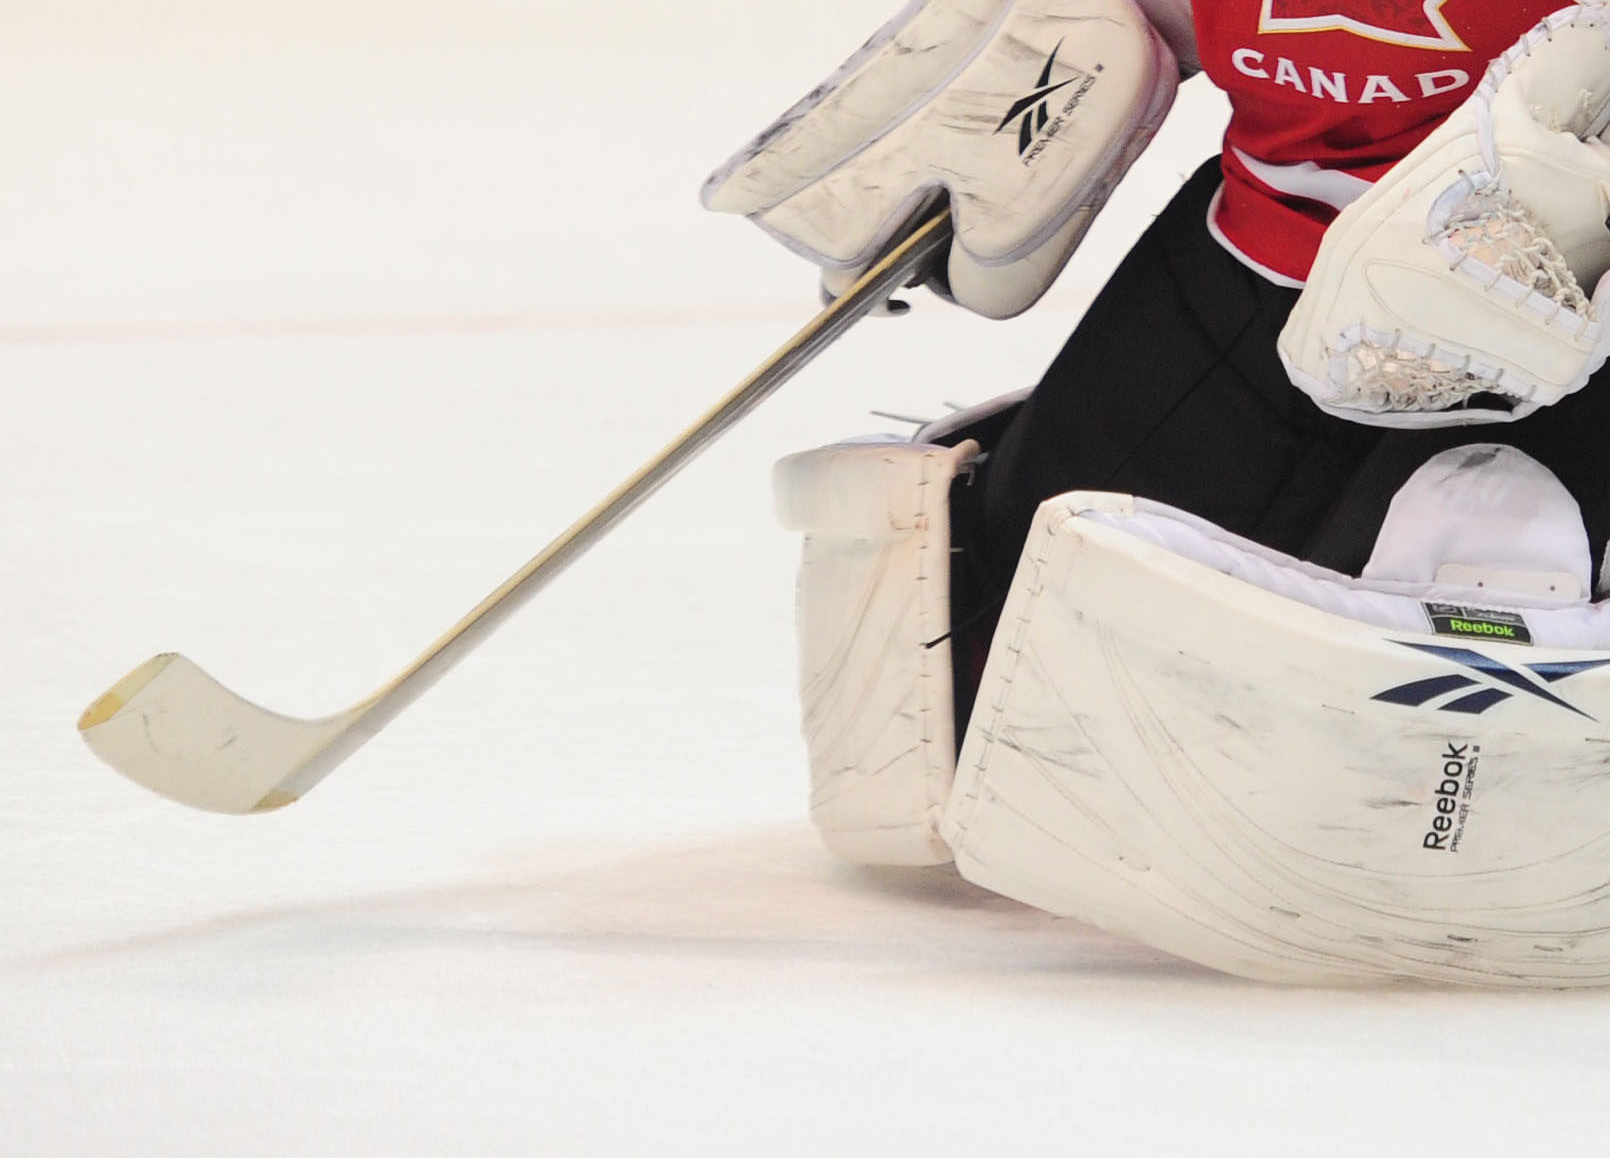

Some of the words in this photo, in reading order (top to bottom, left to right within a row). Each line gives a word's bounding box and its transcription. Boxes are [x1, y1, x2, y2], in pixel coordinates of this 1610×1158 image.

[1231, 48, 1470, 104] CANAD
[1450, 619, 1515, 637] Reebok
[1423, 742, 1468, 850] Reebok
